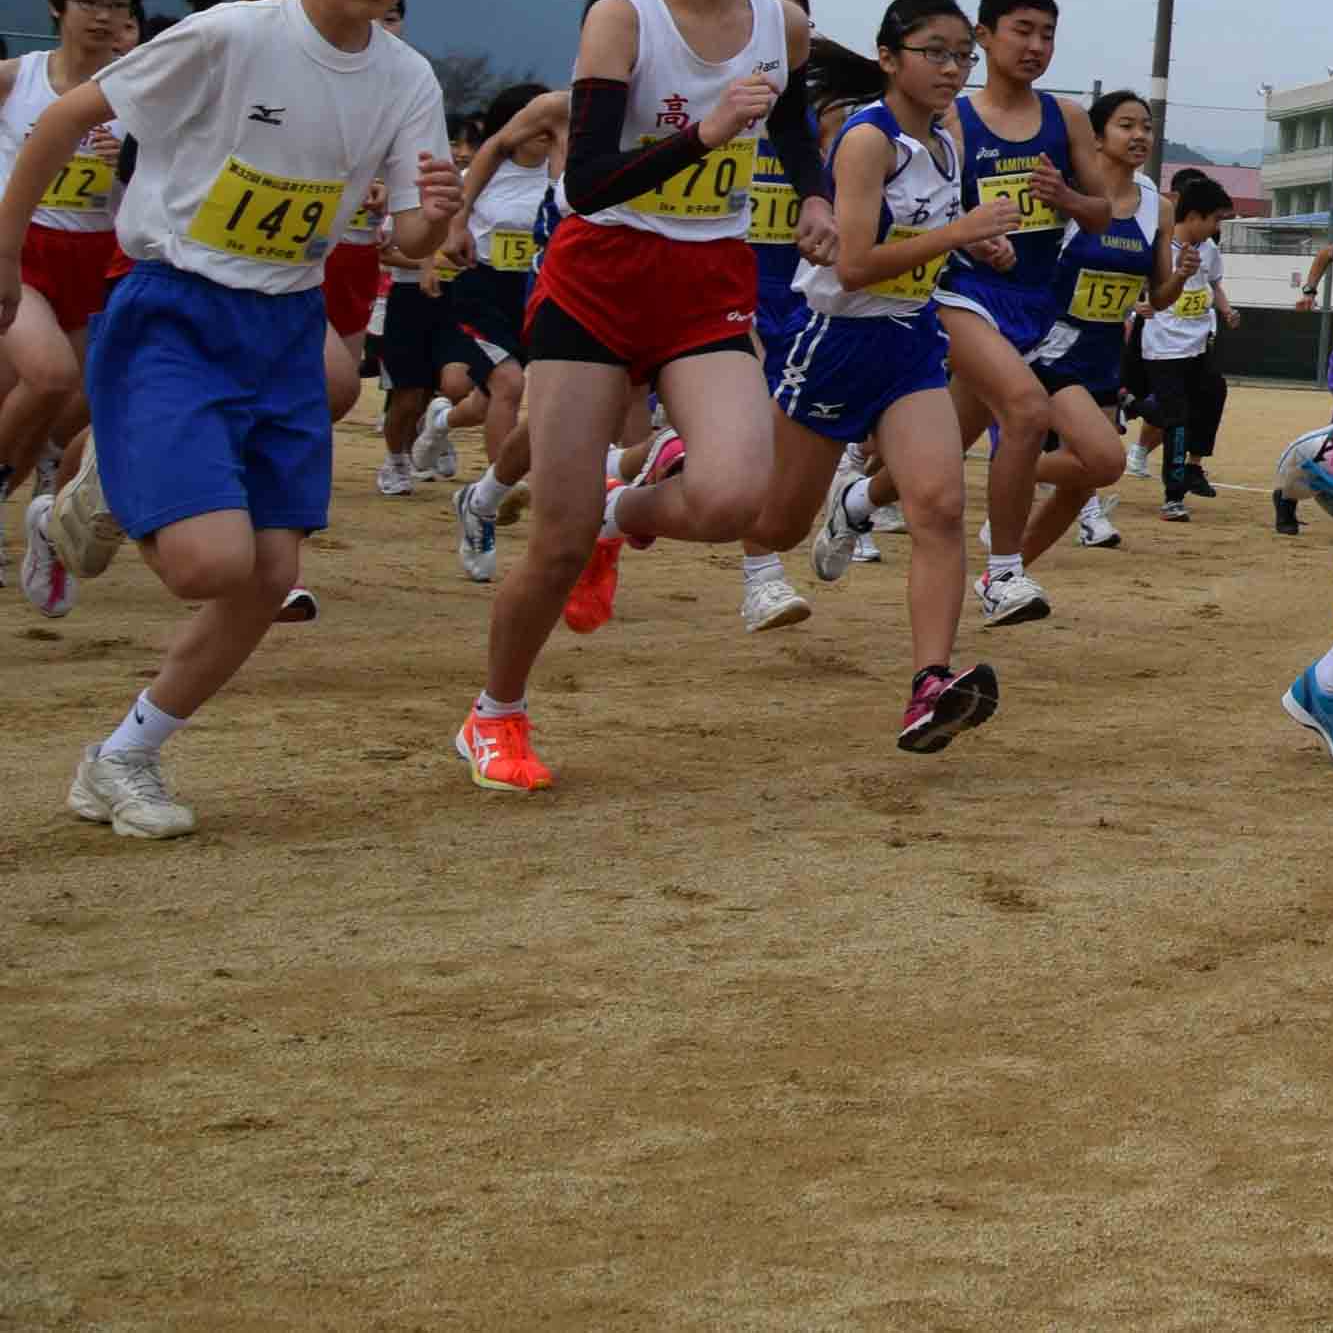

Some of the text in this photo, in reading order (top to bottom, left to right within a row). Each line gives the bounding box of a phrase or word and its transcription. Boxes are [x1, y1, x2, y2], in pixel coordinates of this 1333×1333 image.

[656, 93, 690, 130] 高
[655, 157, 737, 198] 70
[225, 189, 324, 244] 149
[1087, 282, 1130, 309] 157
